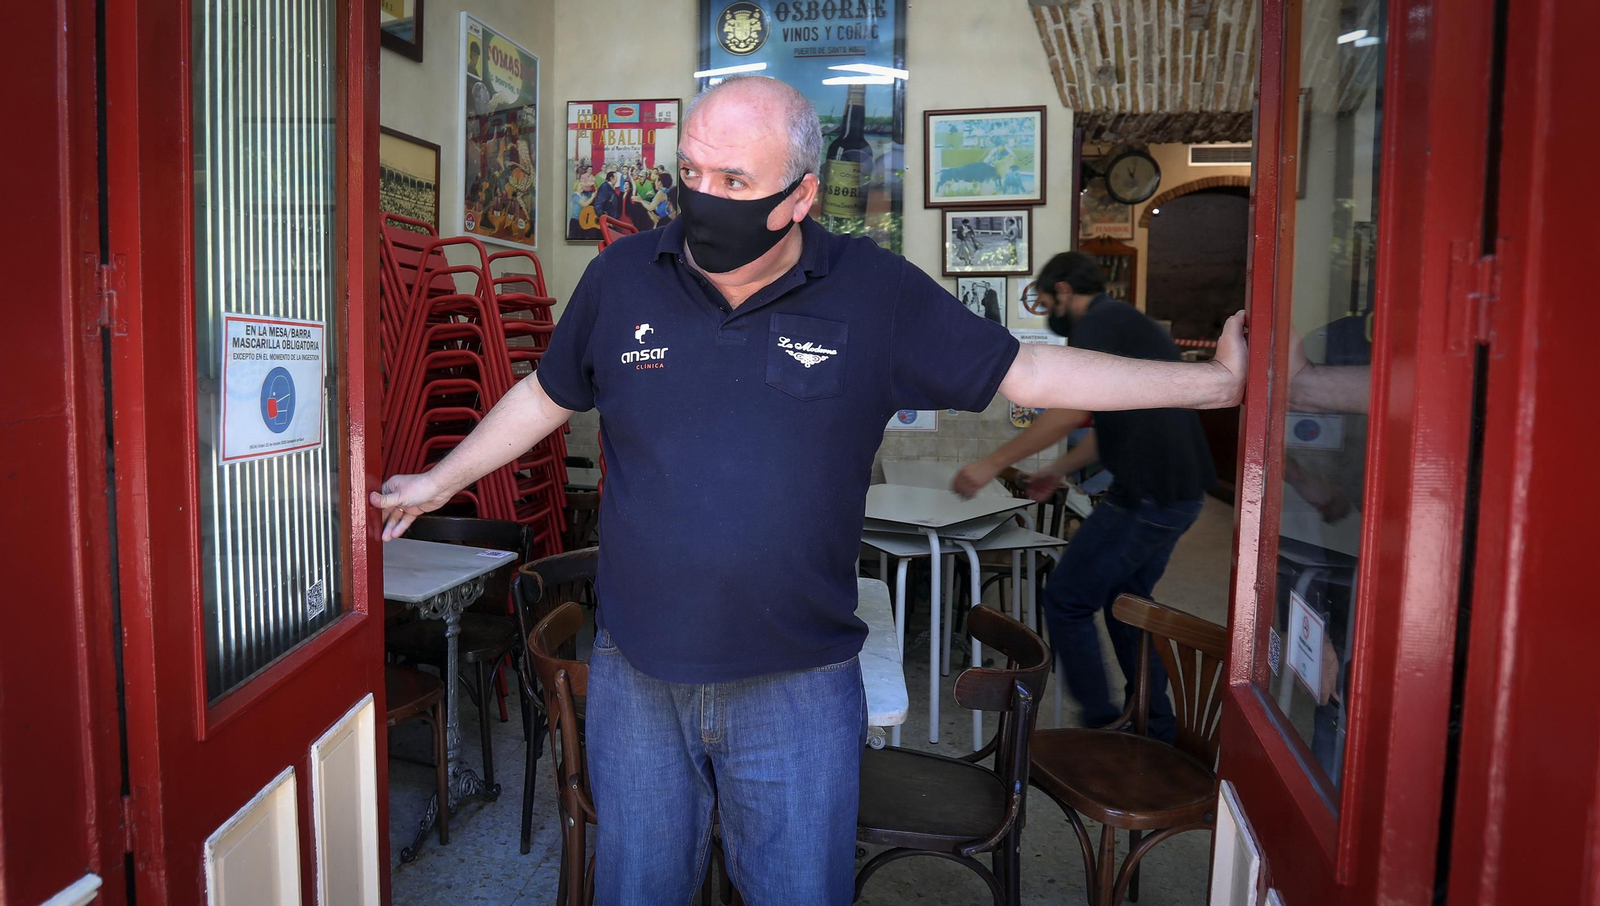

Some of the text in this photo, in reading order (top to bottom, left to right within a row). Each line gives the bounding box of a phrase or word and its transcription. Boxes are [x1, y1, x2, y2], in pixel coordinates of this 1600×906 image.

[774, 0, 887, 22] OSBORNE
[782, 22, 879, 42] VINOS Y COÑAC
[794, 47, 816, 55] PUERTO
[828, 46, 847, 54] SANTA
[577, 113, 609, 130] FERIA
[577, 130, 589, 139] DEL
[590, 129, 656, 146] CABALLO
[246, 325, 311, 339] EN LA MESA/BARRA
[232, 337, 319, 351] MASCARILLA OBLIGATORIA
[777, 336, 837, 355] La Moderna
[233, 352, 255, 360] EXCEPTO
[621, 347, 669, 364] ansar
